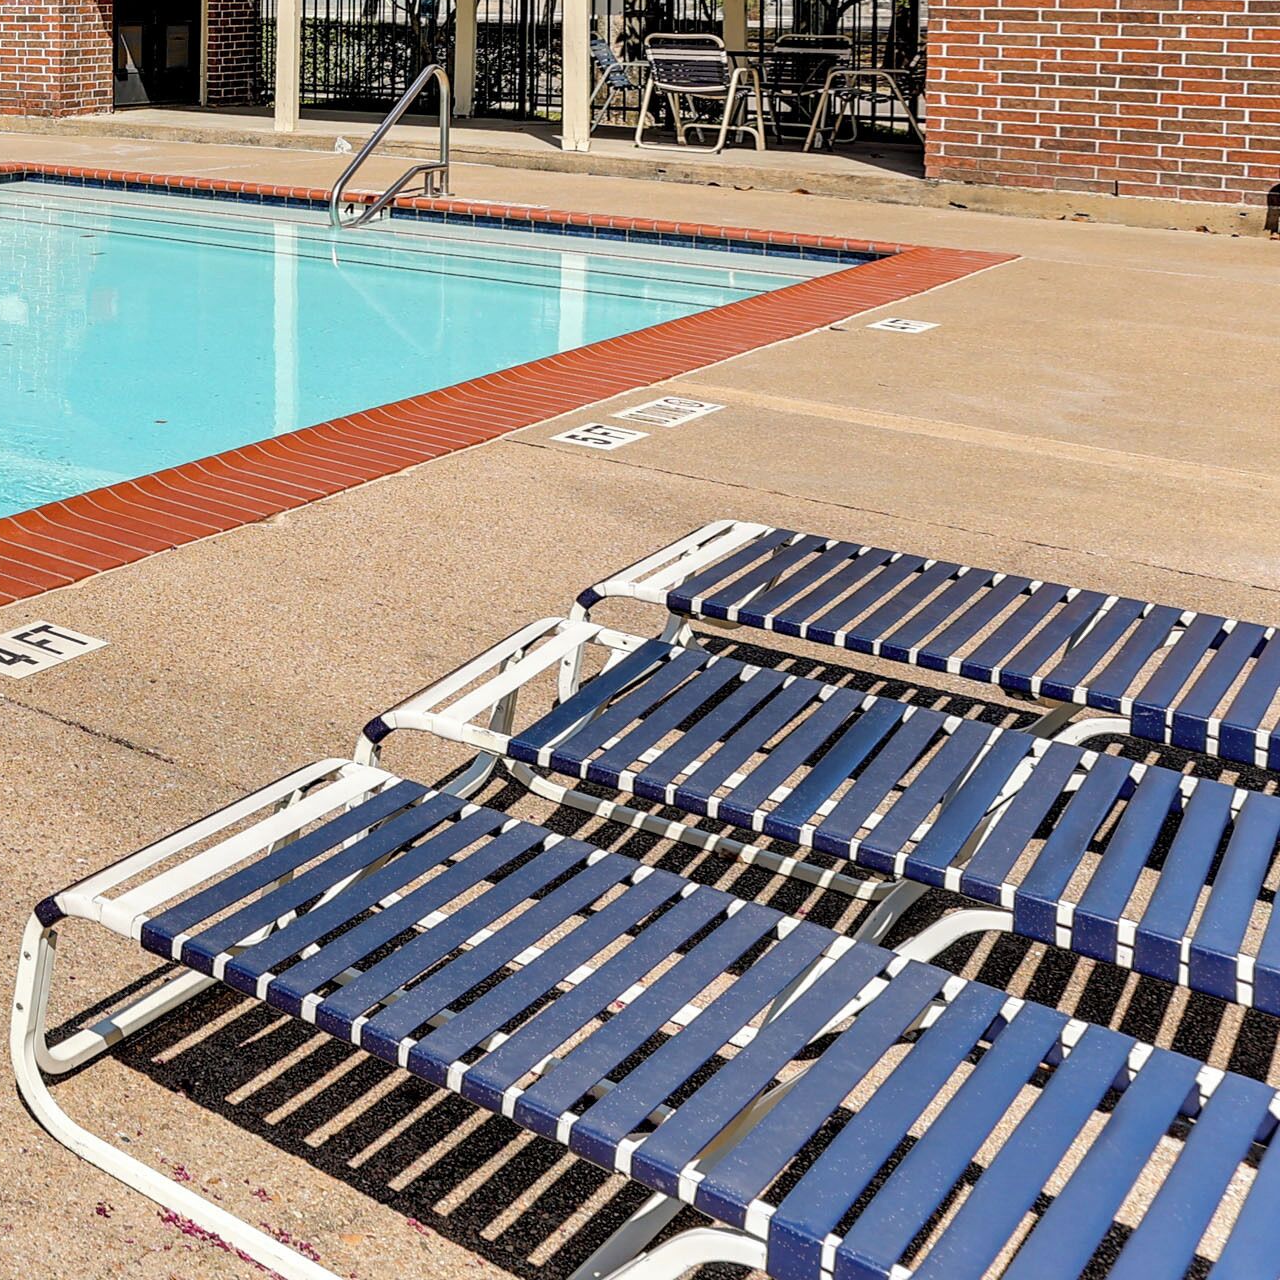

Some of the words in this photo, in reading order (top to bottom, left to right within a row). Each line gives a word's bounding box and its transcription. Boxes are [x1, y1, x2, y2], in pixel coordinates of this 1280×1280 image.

[566, 434, 612, 445] 5
[584, 425, 638, 440] FT
[11, 624, 88, 655] FT
